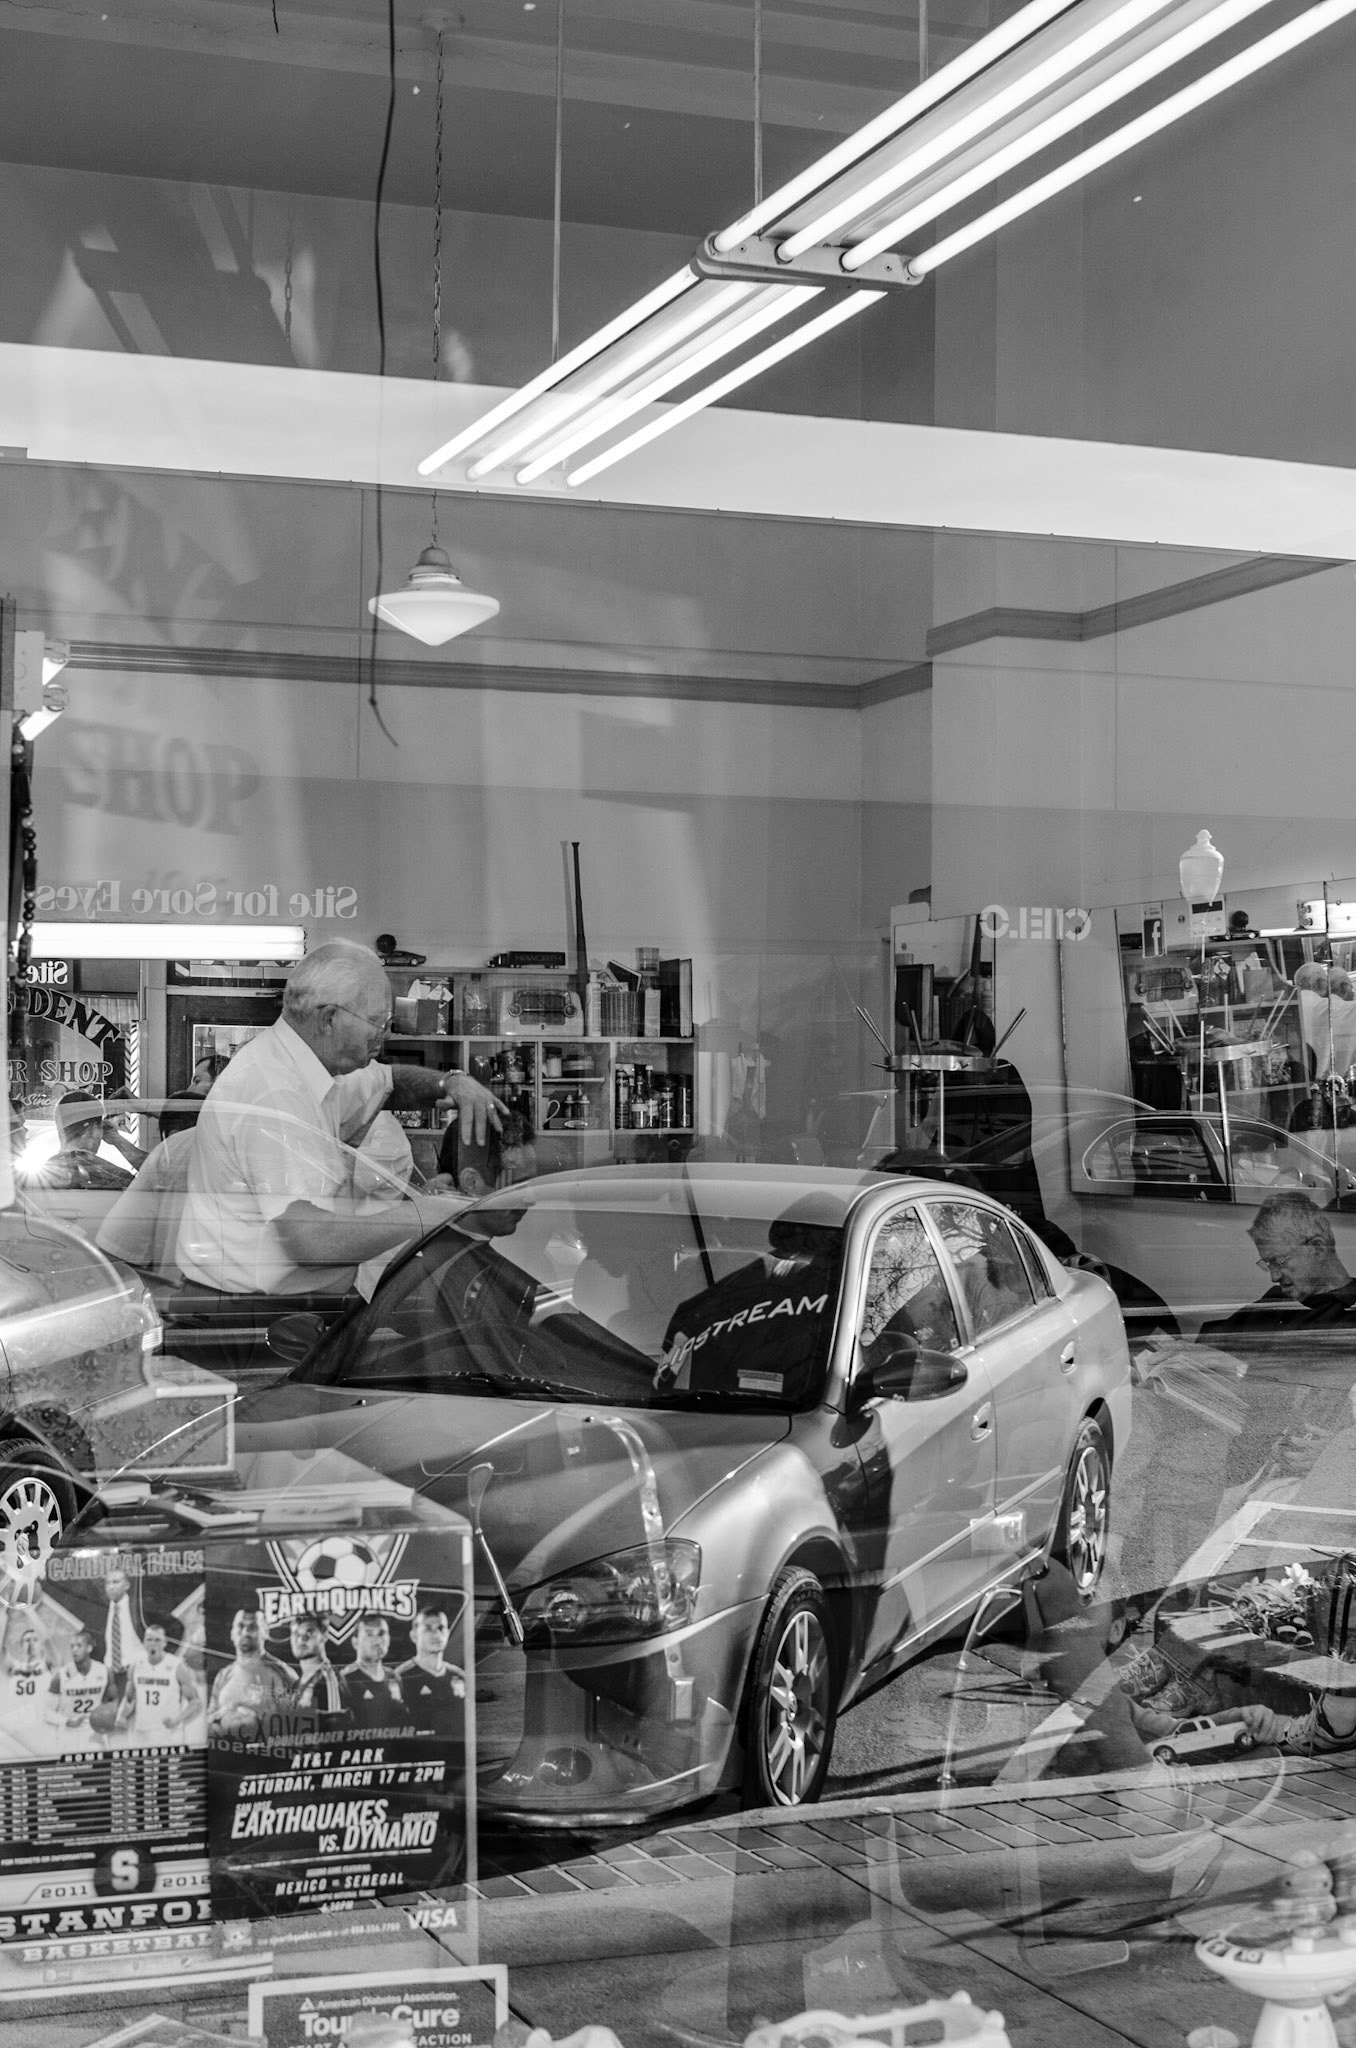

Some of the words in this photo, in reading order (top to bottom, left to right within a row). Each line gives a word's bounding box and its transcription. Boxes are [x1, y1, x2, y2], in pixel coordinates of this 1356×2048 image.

[41, 1060, 114, 1085] SHOP
[49, 1553, 143, 1582] CARDINAL
[147, 1549, 206, 1576] RULES
[263, 1584, 413, 1624] EARTHQUAKES
[15, 1680, 35, 1695] 50
[145, 1690, 160, 1706] 13
[73, 1699, 93, 1714] 22
[347, 1726, 416, 1741] SPECTACULAR
[65, 1753, 103, 1763] HOME
[112, 1745, 186, 1760] SCHEDULE
[291, 1750, 334, 1769] AT&T
[340, 1748, 385, 1765] PARK
[238, 1775, 315, 1797] SATURDAY,
[321, 1770, 373, 1789] MARCH
[379, 1769, 396, 1786] 17
[414, 1766, 445, 1783] 2PM
[231, 1798, 389, 1839] EARTHQUAKES
[319, 1834, 340, 1853] VS.
[342, 1819, 438, 1851] DYNAMO
[111, 1849, 139, 1892] S
[162, 1874, 211, 1888] 2012
[41, 1885, 88, 1898] 2011
[275, 1877, 328, 1897] MEXICO
[344, 1871, 404, 1889] SENEGAL
[408, 1907, 458, 1929] VISA
[317, 1998, 361, 2010] American
[362, 1995, 402, 2007] Diabetes
[391, 2004, 461, 2029] Cure
